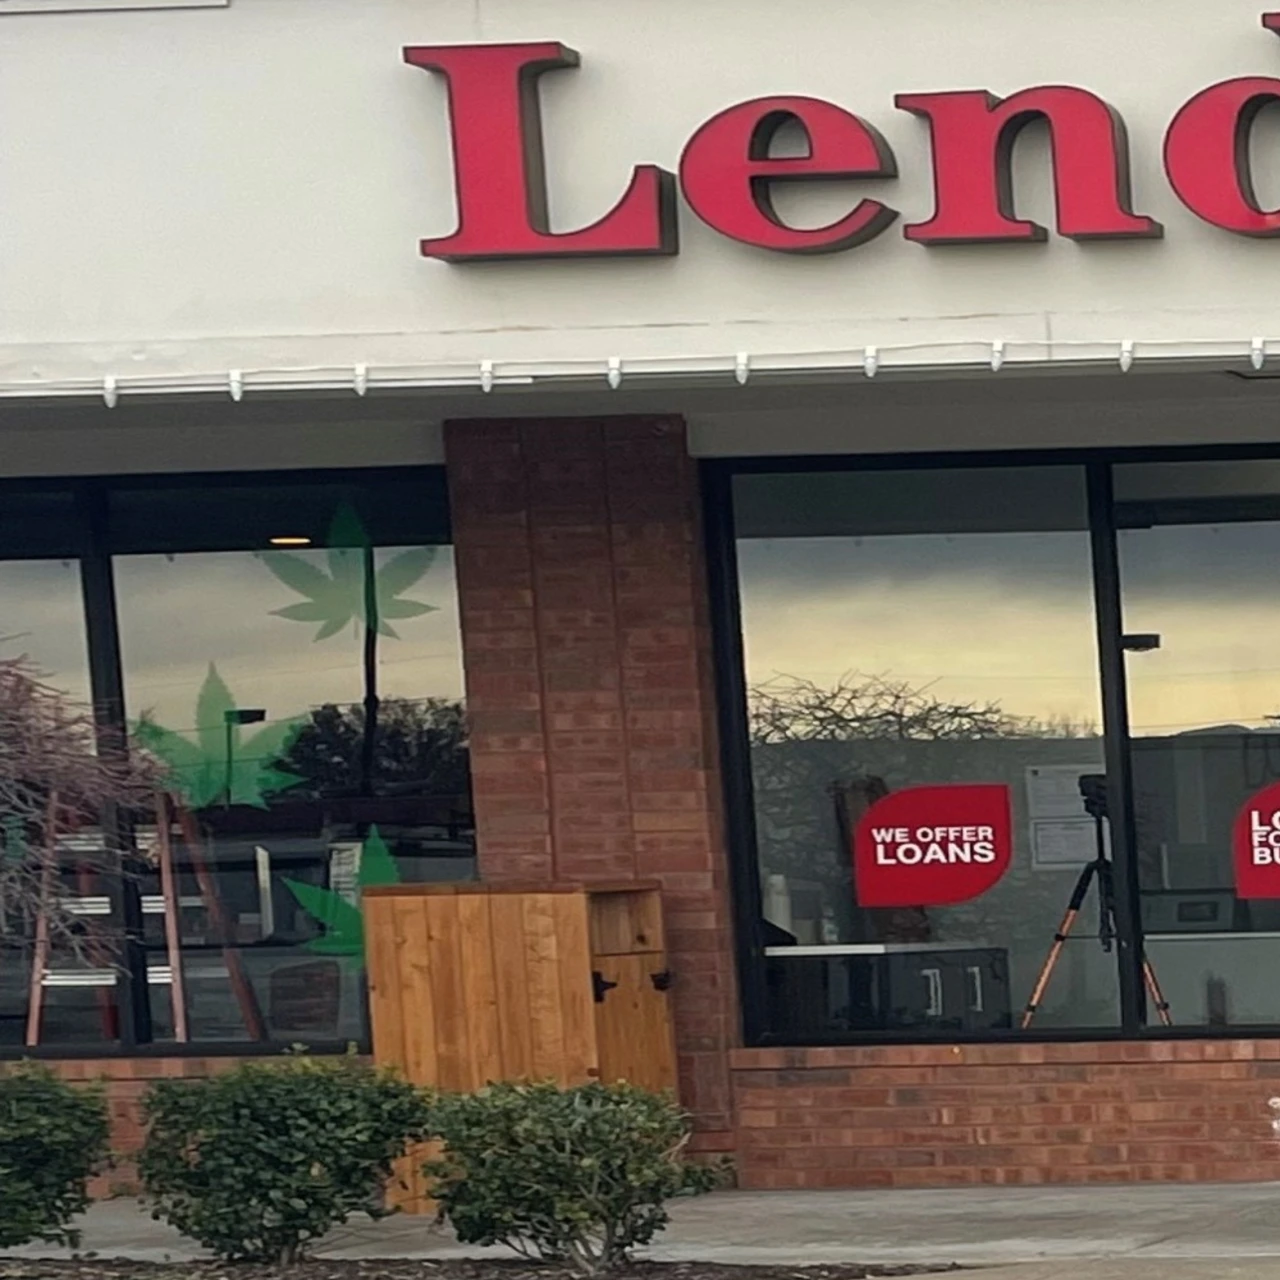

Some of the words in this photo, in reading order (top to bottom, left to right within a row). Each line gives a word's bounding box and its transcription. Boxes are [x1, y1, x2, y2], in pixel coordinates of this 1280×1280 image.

[871, 828, 909, 843] WE
[916, 825, 994, 842] OFFER
[876, 841, 995, 864] LOANS
